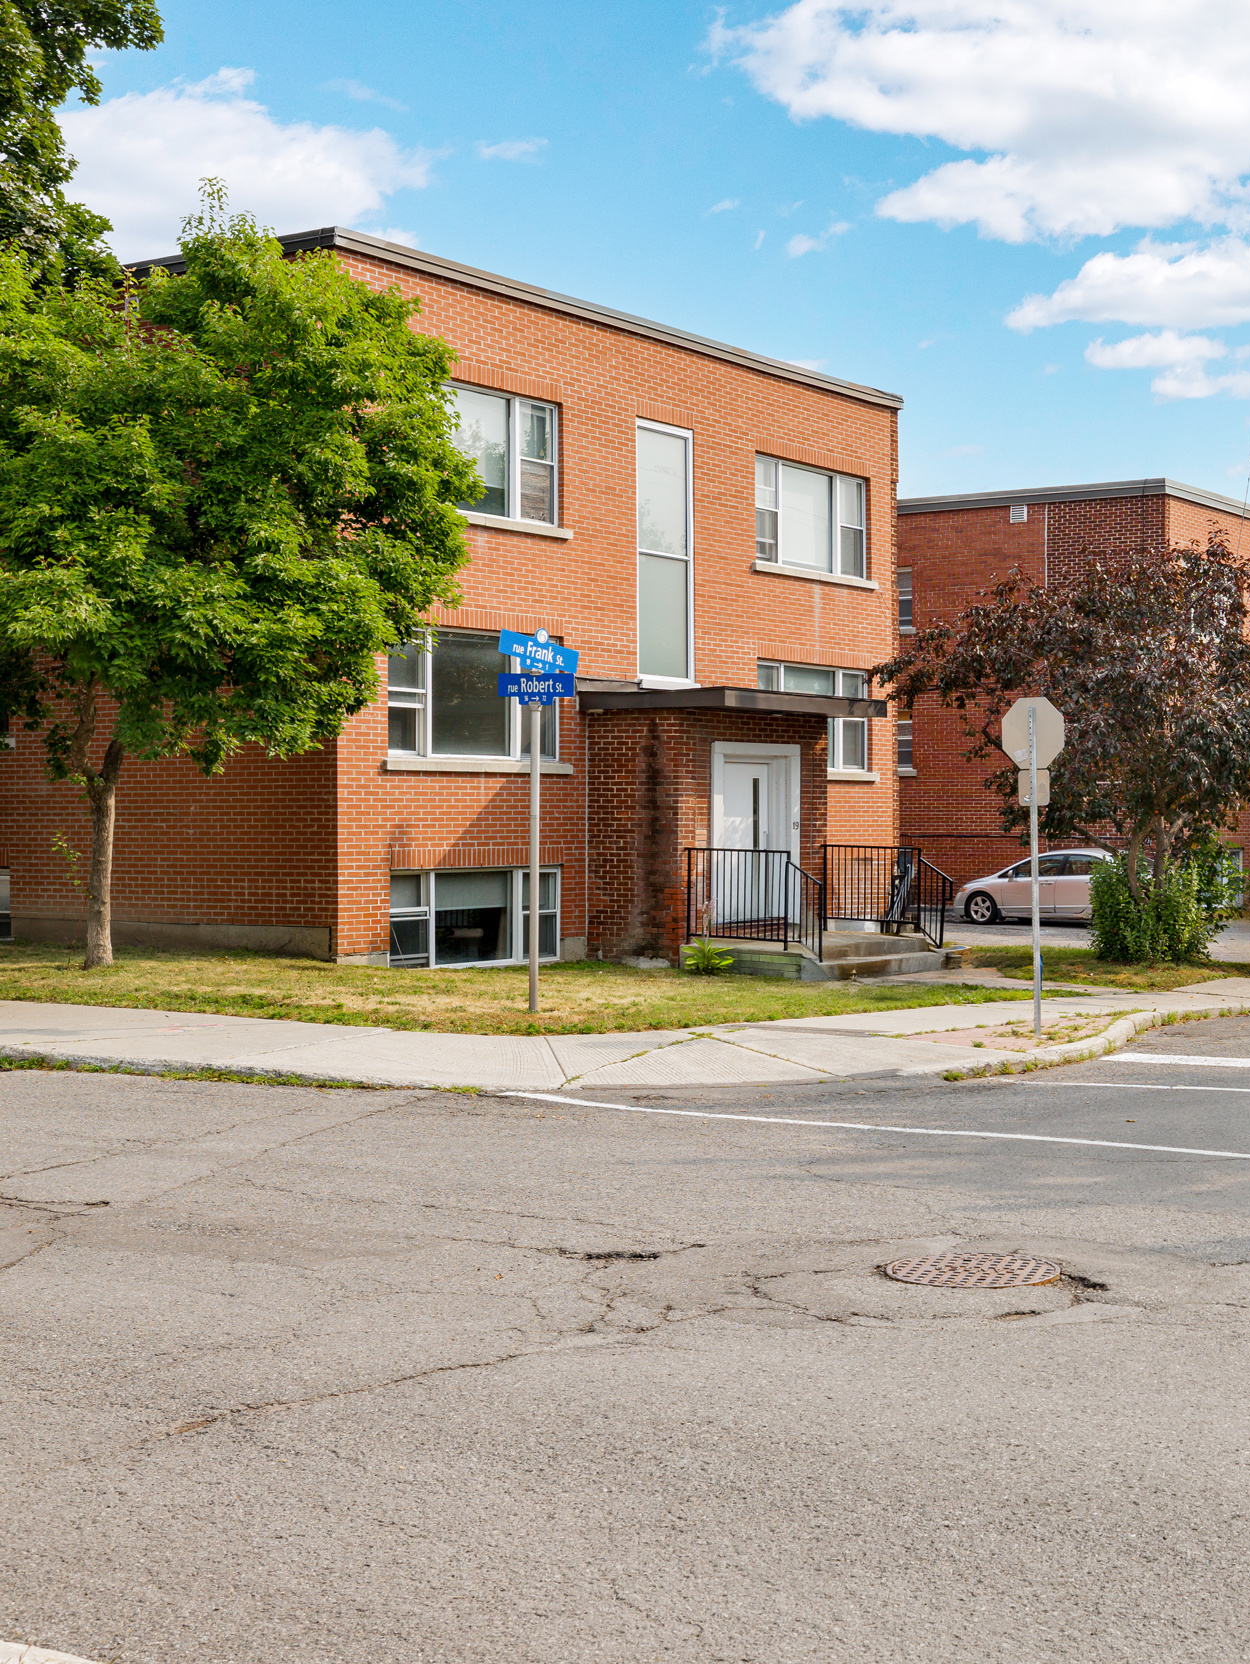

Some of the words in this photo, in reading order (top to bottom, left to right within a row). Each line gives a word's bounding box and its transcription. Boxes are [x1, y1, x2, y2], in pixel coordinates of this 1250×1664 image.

[512, 643, 525, 655] rue
[526, 641, 555, 663] Frank
[507, 683, 519, 693] rue
[520, 677, 554, 693] Robert
[792, 821, 799, 830] 19
